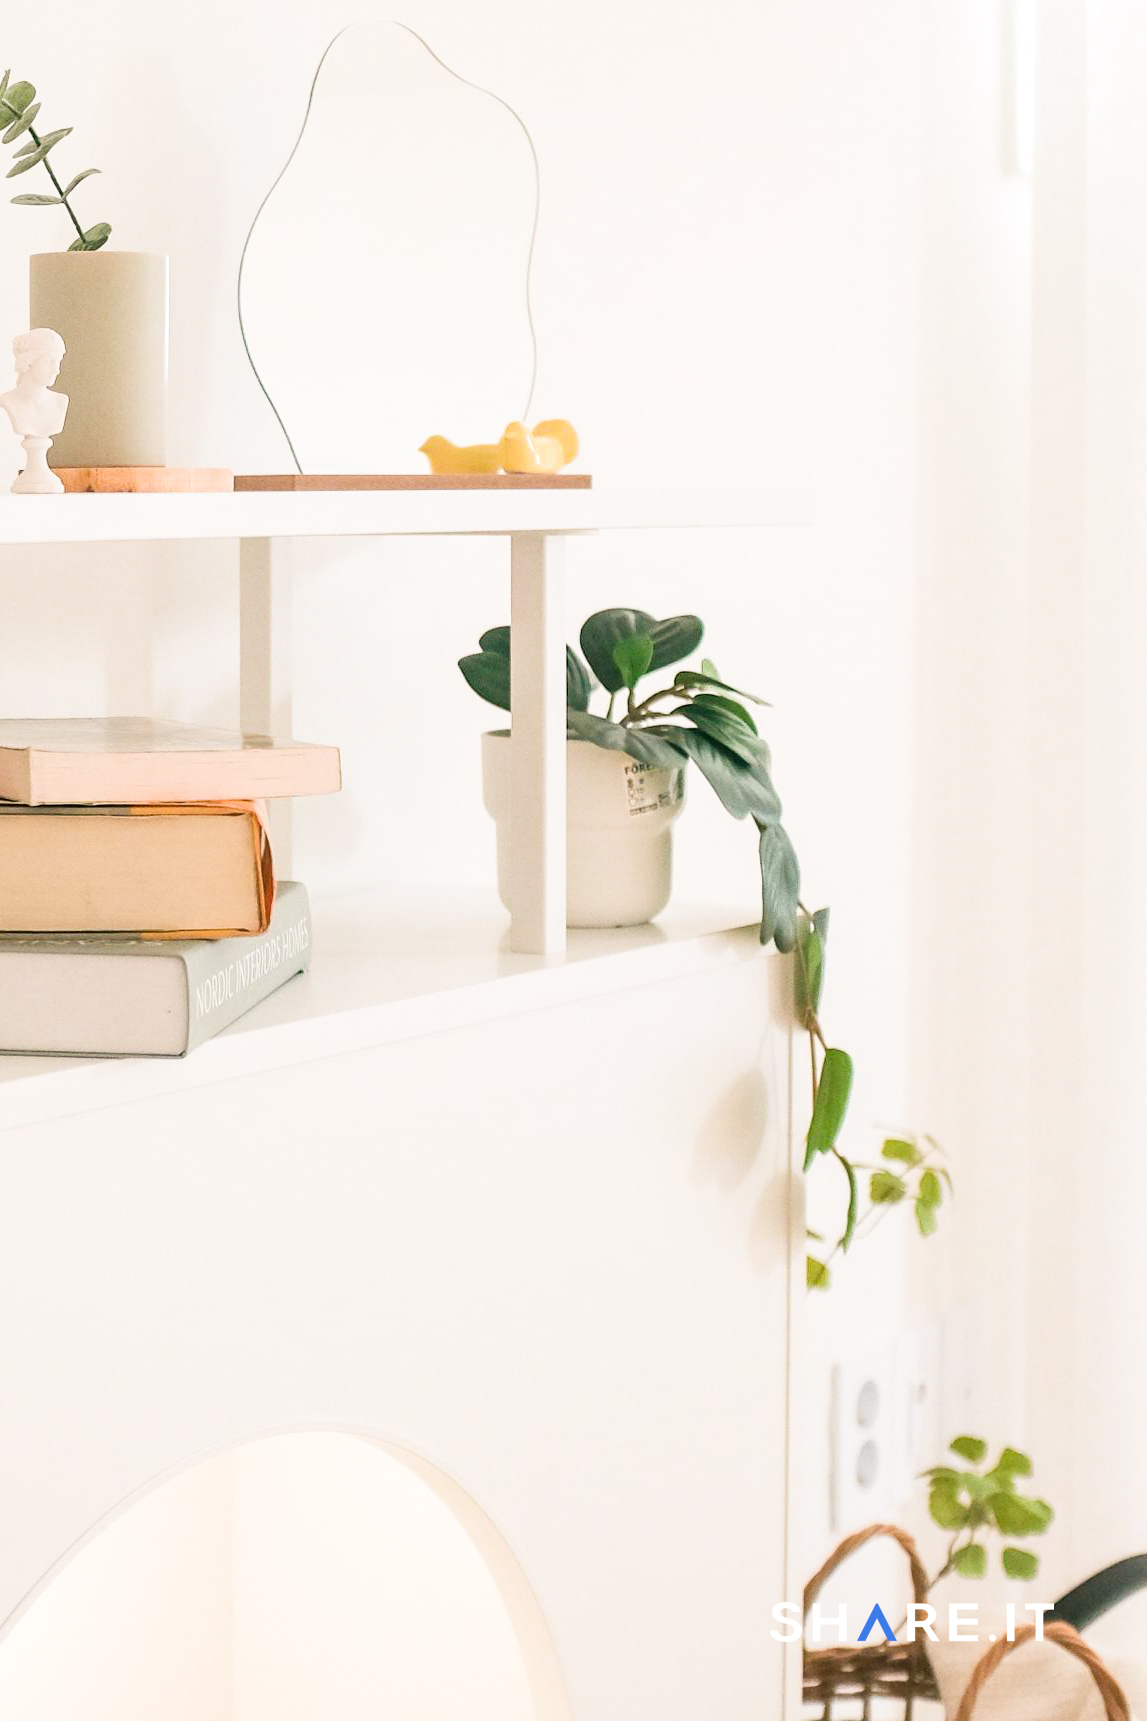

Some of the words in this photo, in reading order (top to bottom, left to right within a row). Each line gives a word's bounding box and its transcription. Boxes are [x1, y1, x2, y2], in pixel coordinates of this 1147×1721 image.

[196, 964, 234, 1019] NORDIC
[235, 935, 282, 993] INTERIORS
[281, 920, 308, 961] HOMES
